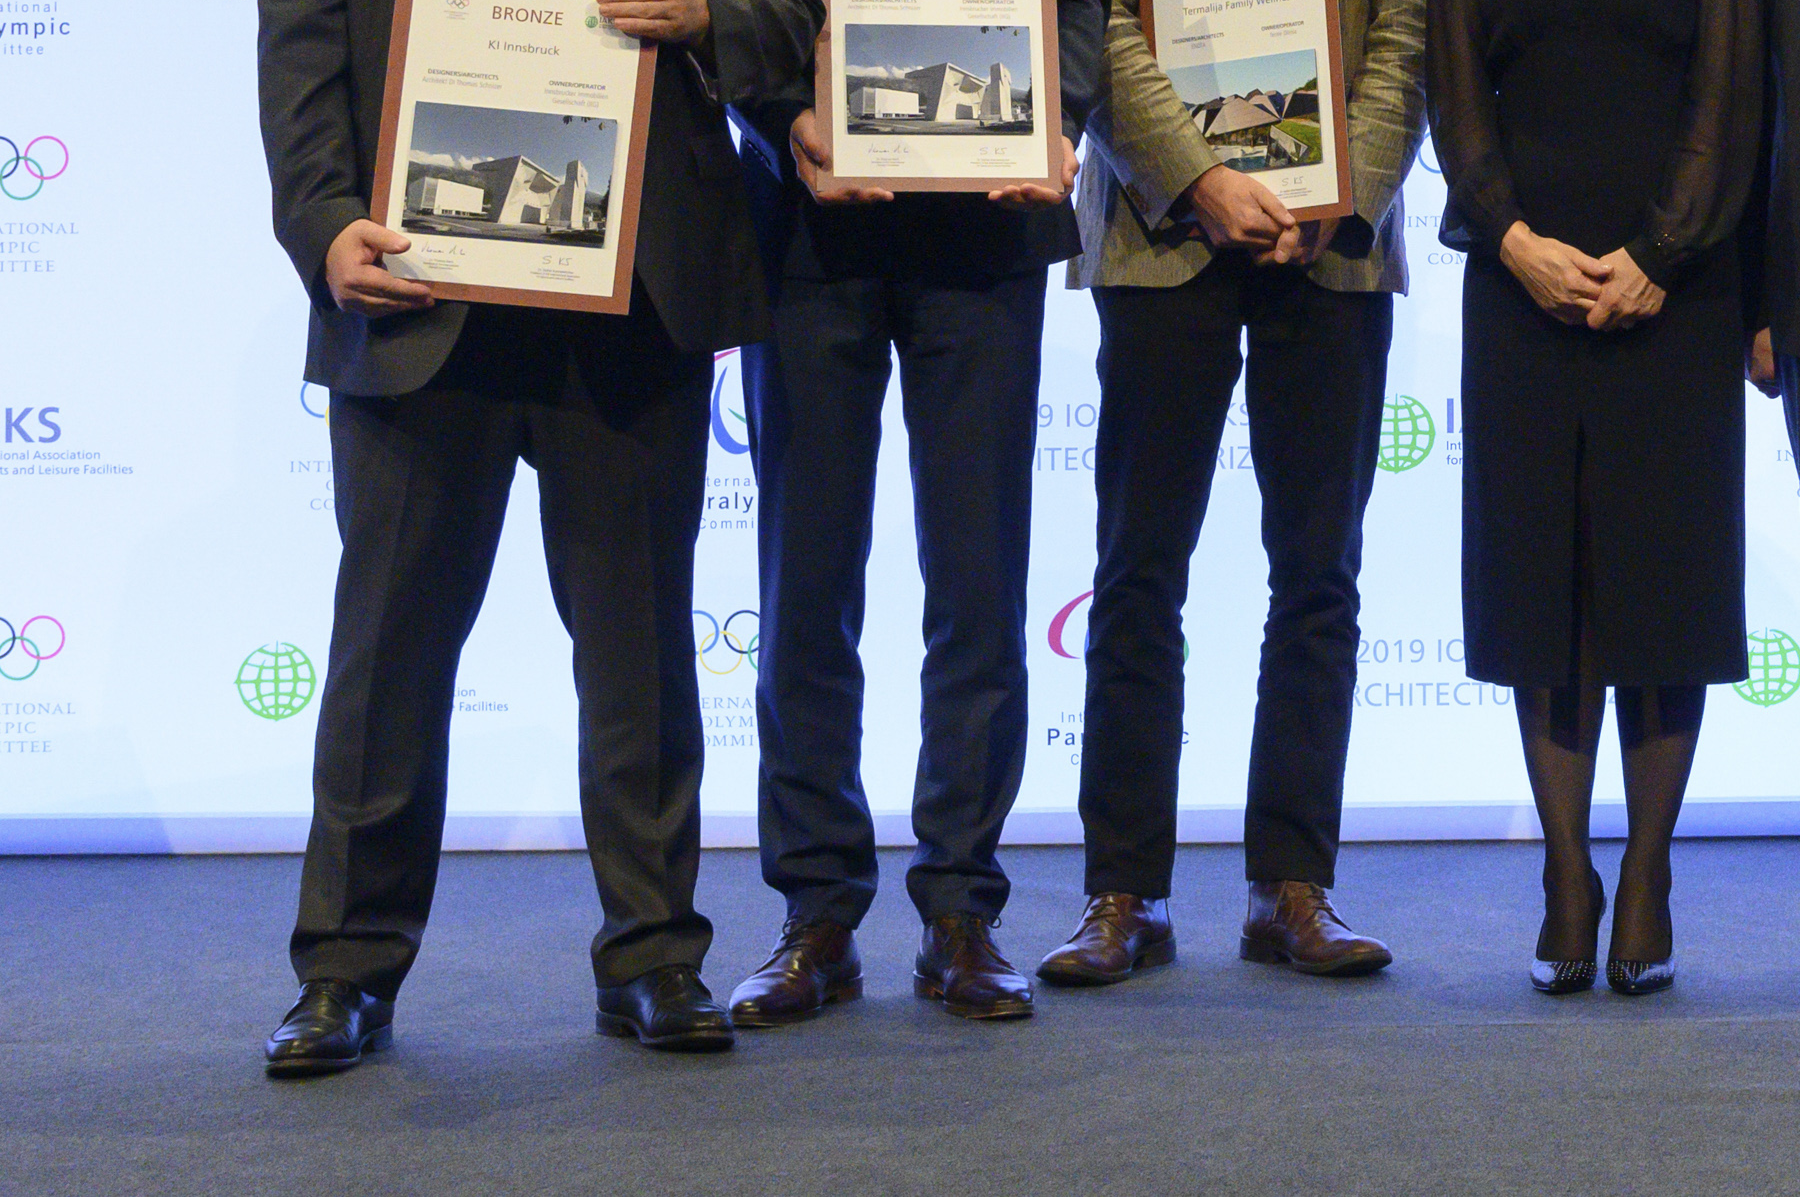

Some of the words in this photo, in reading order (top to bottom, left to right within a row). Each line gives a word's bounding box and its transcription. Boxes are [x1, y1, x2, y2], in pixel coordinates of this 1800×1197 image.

[491, 5, 564, 26] BRONZE
[1183, 1, 1223, 17] Termalija
[0, 17, 70, 39] ympic
[3, 44, 44, 55] ittee
[488, 39, 500, 50] KI
[503, 40, 561, 57] Innsbruck
[549, 79, 607, 91] OWNER/OPERATOR
[0, 260, 54, 273] ITTEE
[1066, 403, 1098, 427] IO
[5, 406, 61, 443] KS
[33, 450, 101, 460] Association
[12, 465, 35, 475] and
[38, 465, 80, 475] Leisure
[83, 464, 134, 475] Facilities
[700, 517, 754, 529] Commi
[1357, 639, 1425, 663] 2019
[1437, 638, 1465, 663] IO
[459, 701, 509, 712] Facilities
[702, 715, 754, 728] OLYM
